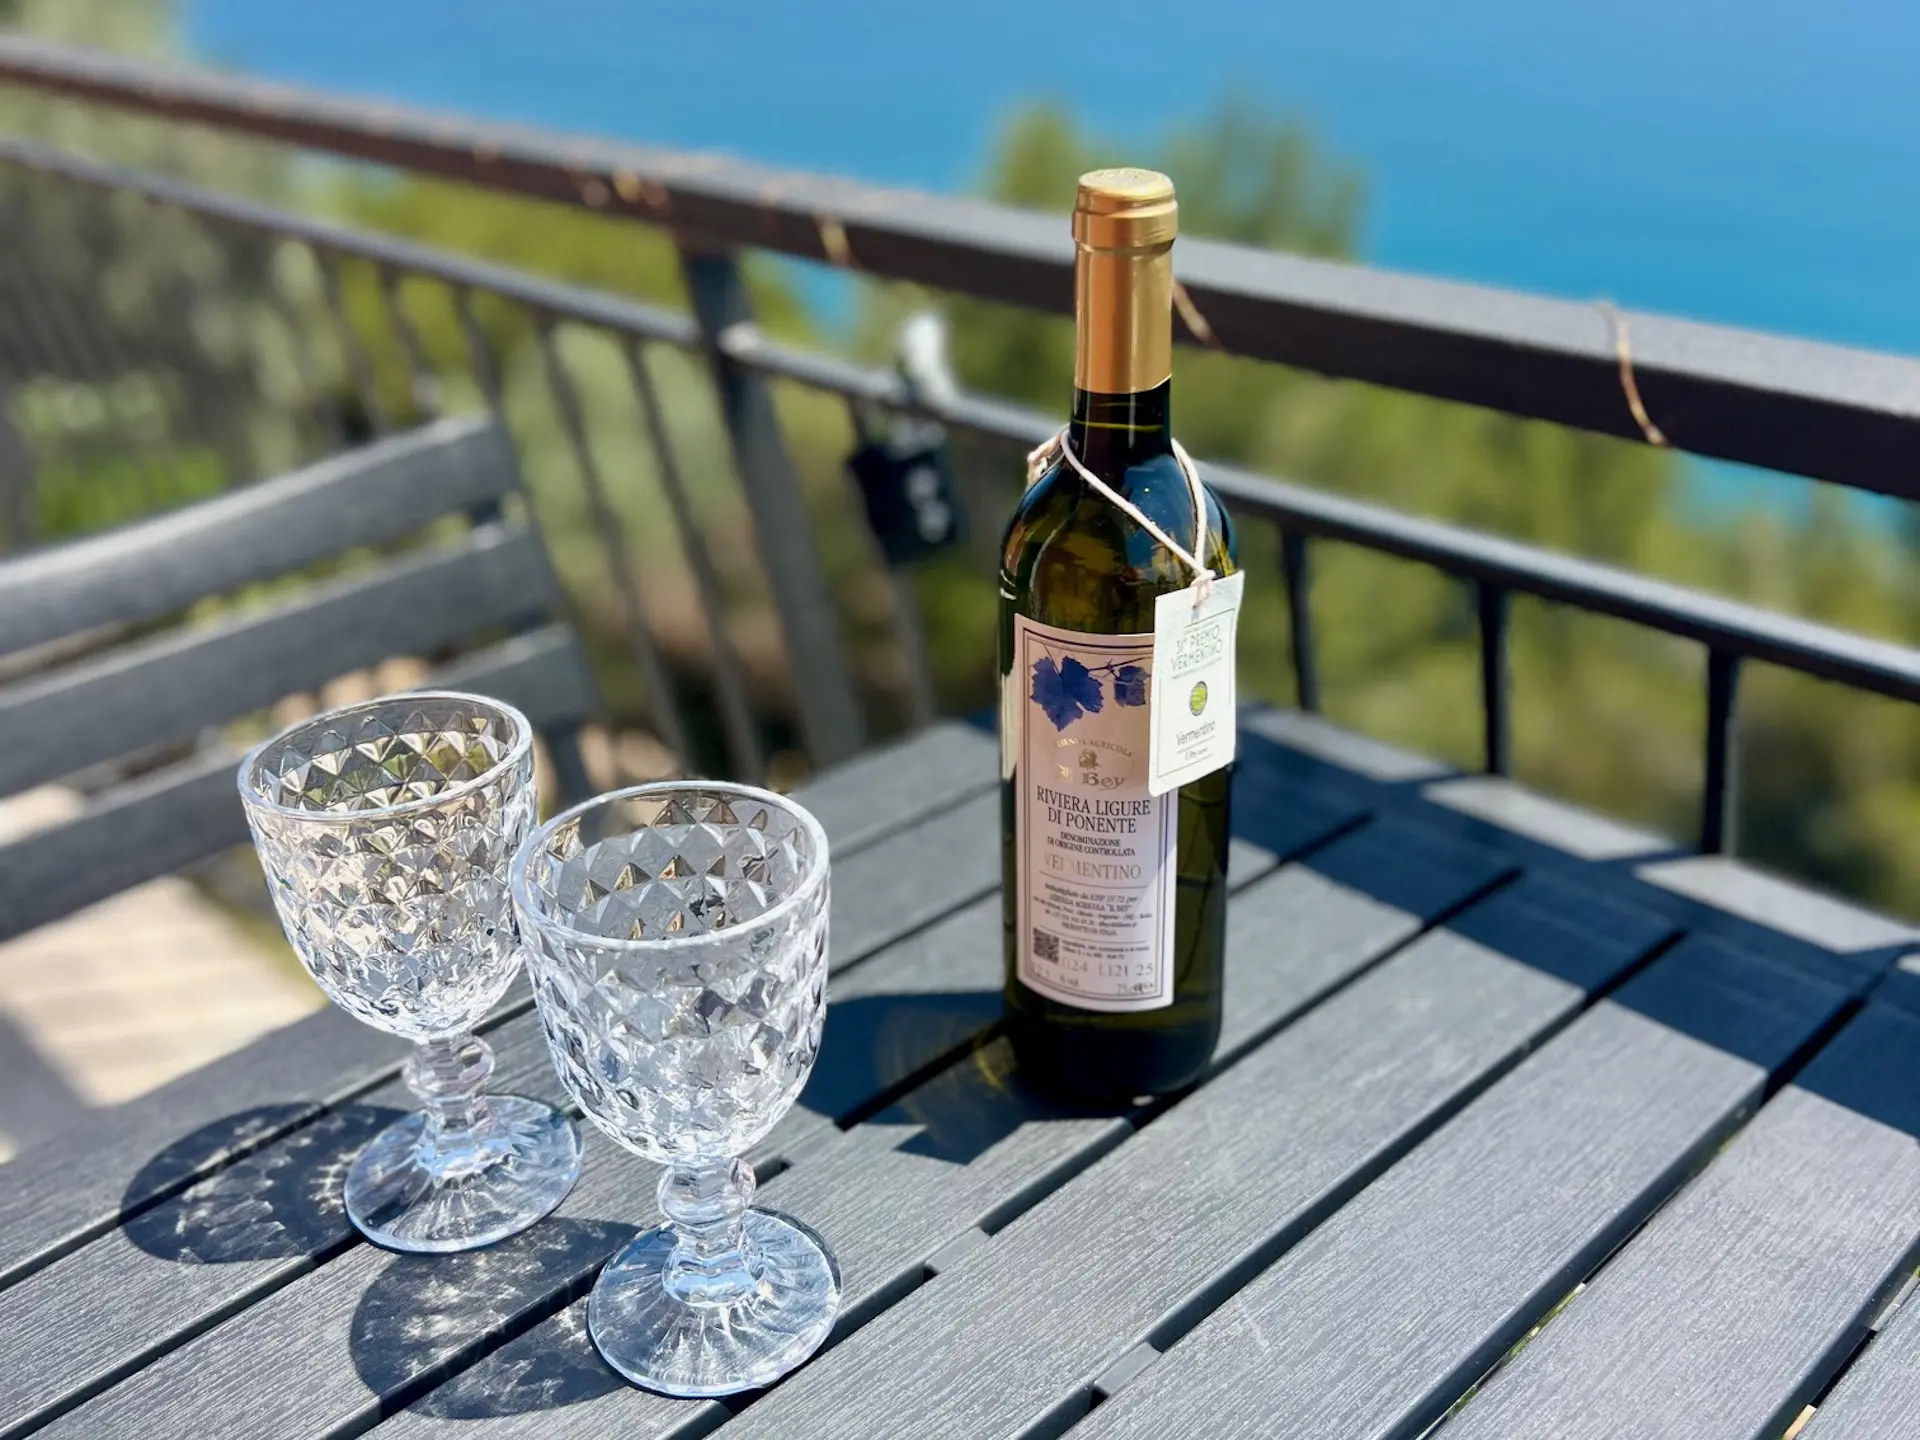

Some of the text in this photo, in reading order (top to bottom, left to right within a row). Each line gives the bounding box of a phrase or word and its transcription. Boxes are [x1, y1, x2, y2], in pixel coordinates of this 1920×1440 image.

[1171, 638, 1222, 674] VERMENTINO
[1176, 719, 1216, 746] Vermentino
[1090, 739, 1133, 758] AGRICOLA
[1081, 771, 1127, 791] Bey
[1036, 785, 1151, 816] RIVIERA LIGURE
[1048, 807, 1137, 833] DI PONENTE
[1047, 836, 1136, 857] DI ORIGINE CONTROLLATA
[1060, 831, 1121, 847] DENOMINAZIONE
